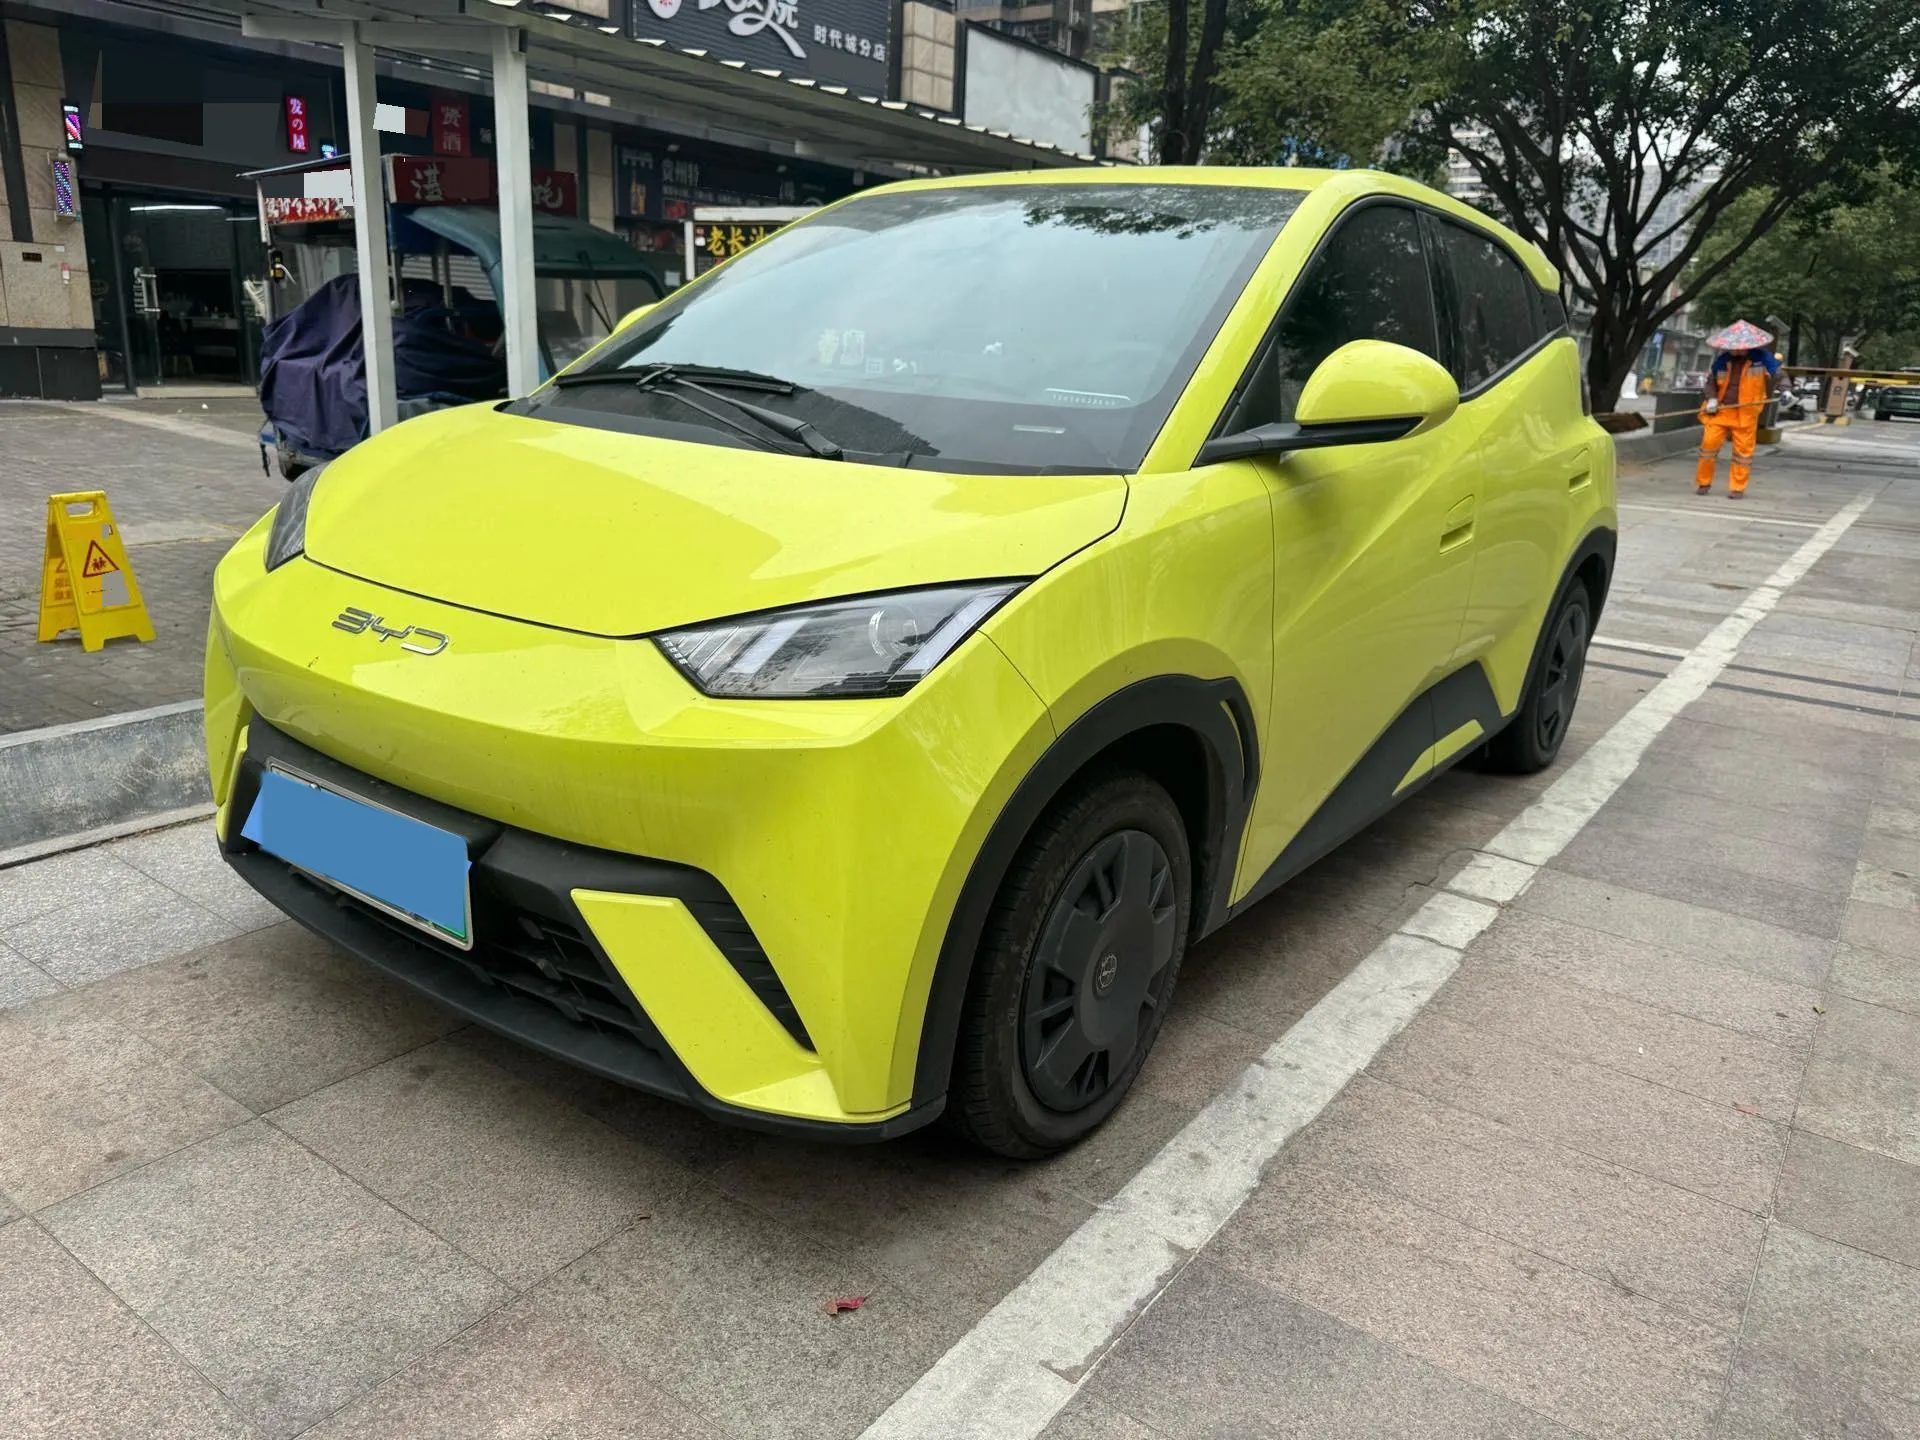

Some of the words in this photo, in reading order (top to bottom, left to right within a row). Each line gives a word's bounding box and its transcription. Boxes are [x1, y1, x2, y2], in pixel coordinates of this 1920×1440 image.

[813, 24, 886, 62] 时代城分店
[331, 606, 449, 656] BYD
